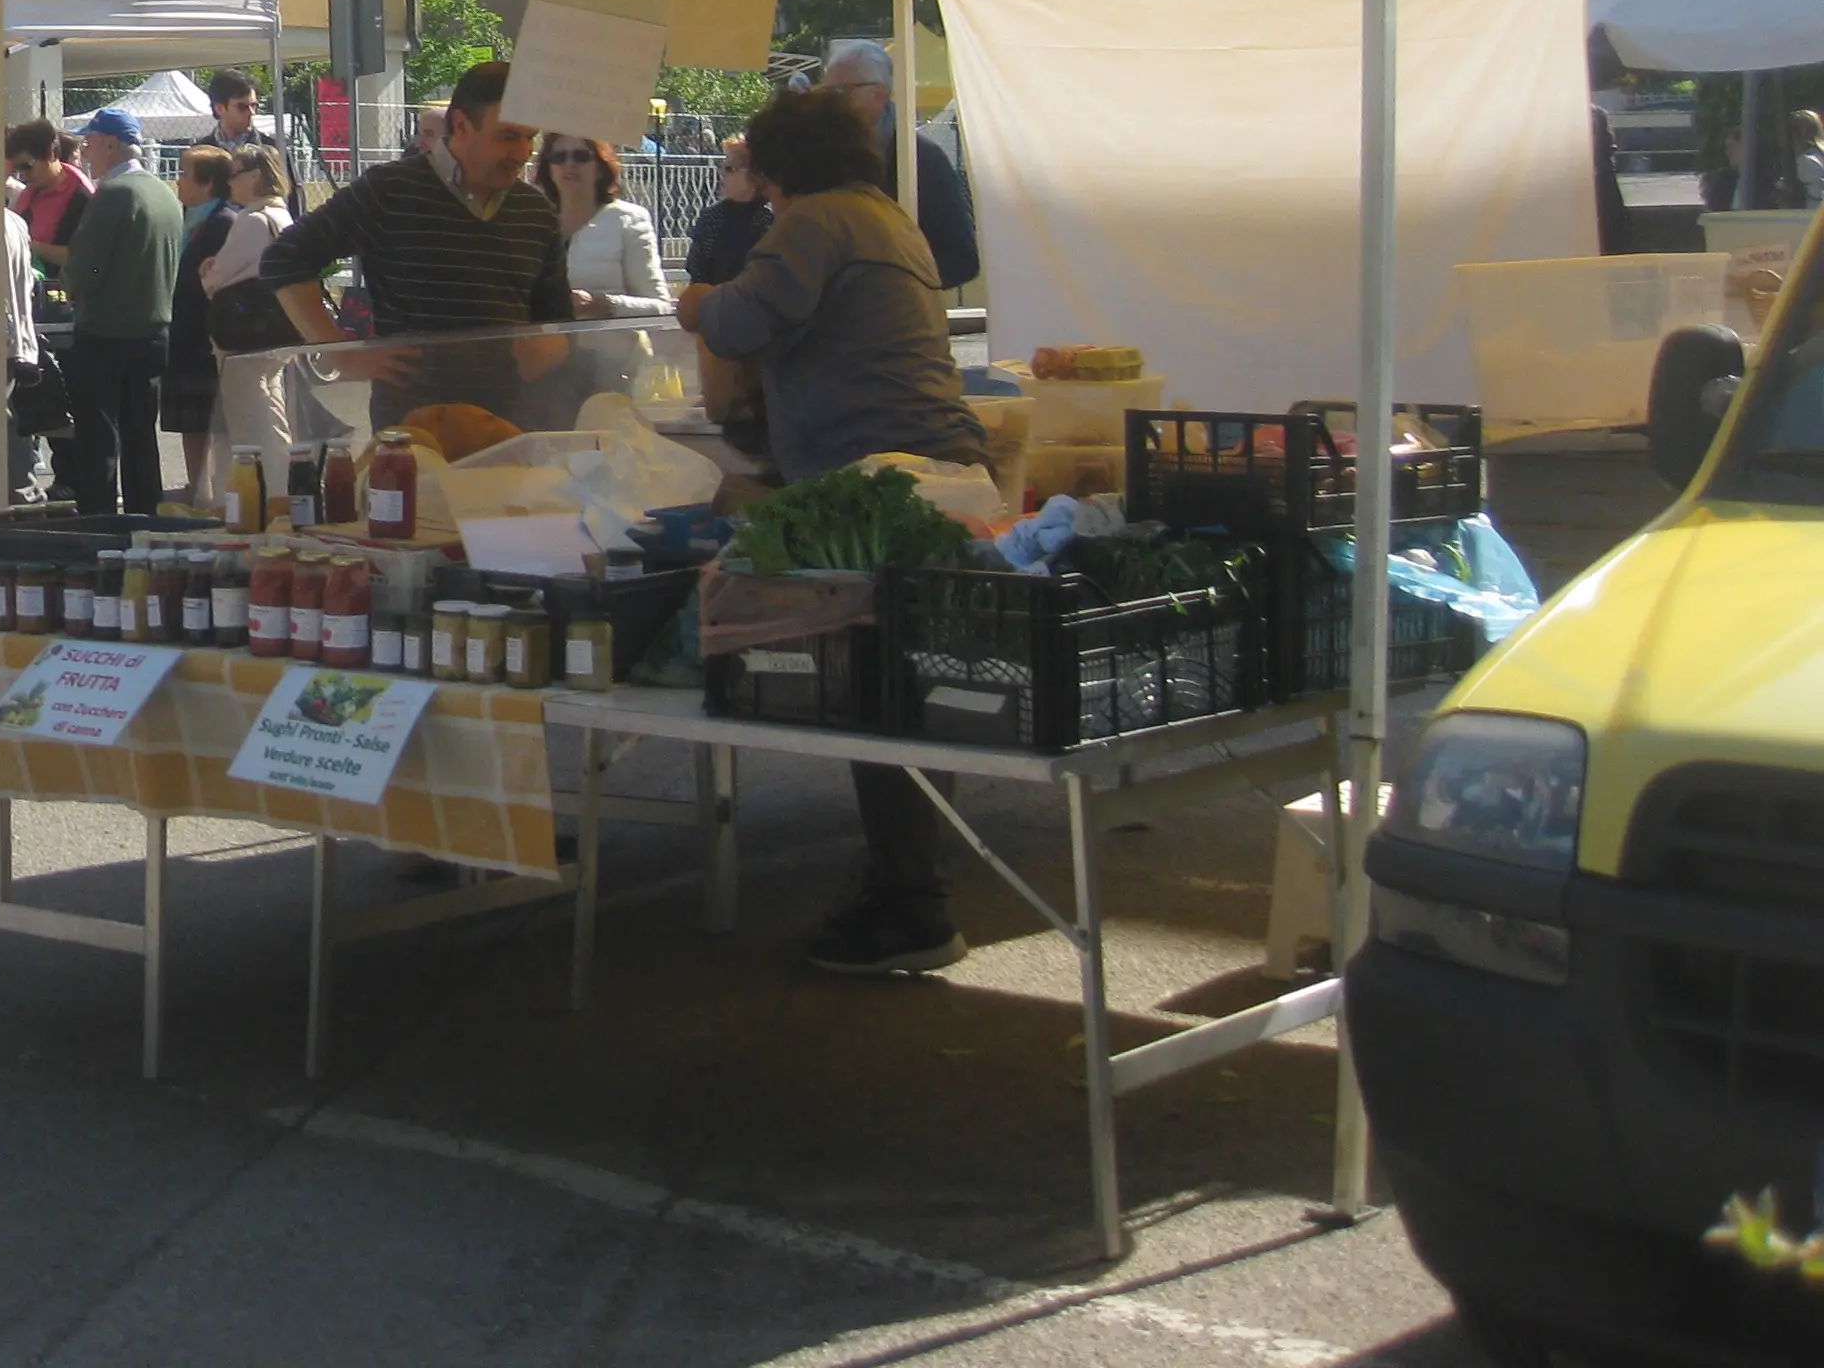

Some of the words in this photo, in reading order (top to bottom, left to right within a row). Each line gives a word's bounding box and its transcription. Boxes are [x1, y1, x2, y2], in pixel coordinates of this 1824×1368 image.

[61, 649, 126, 667] SUCCHI
[124, 653, 146, 669] di
[55, 671, 121, 692] FRUTTA
[257, 717, 299, 739] Sughi
[299, 723, 345, 745] Pronti
[352, 733, 391, 754] Salse
[263, 744, 314, 768] Verdure
[315, 755, 362, 776] scelte
